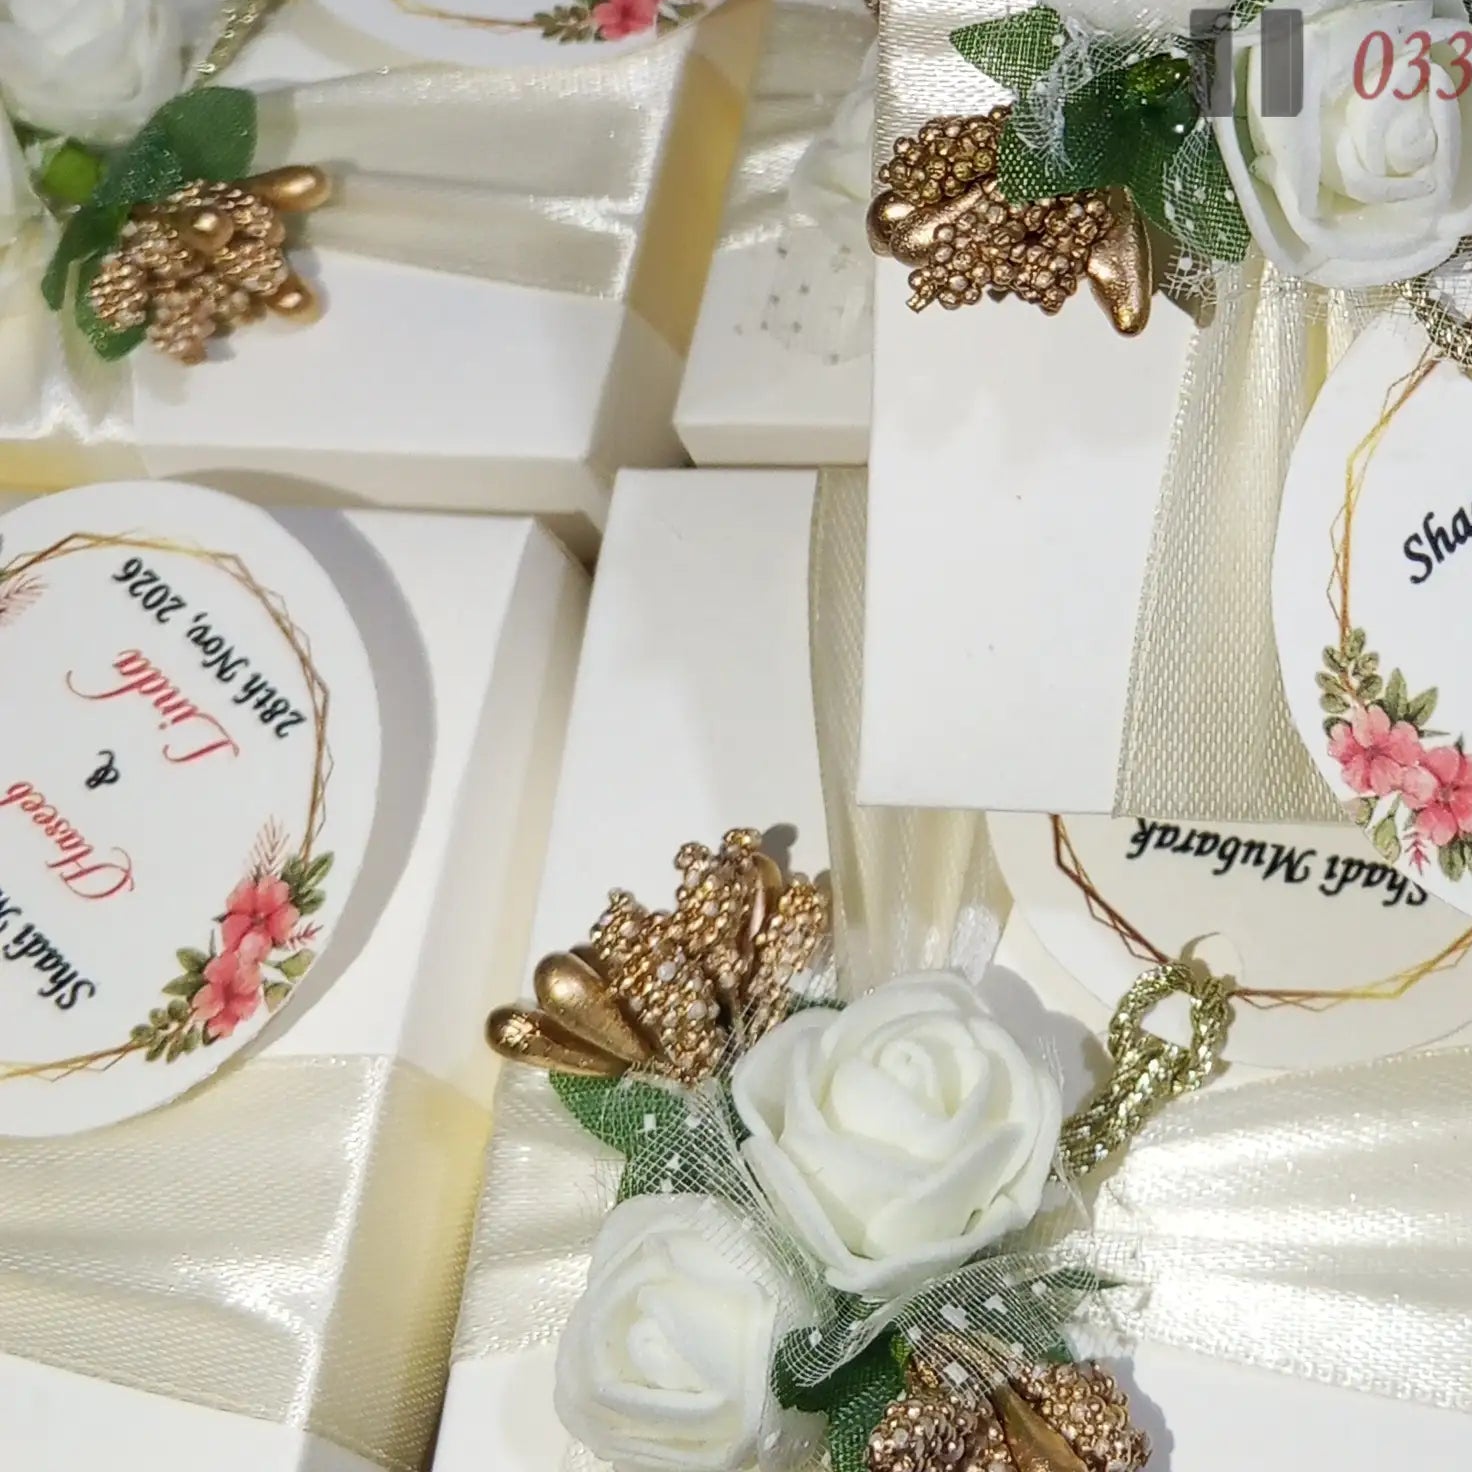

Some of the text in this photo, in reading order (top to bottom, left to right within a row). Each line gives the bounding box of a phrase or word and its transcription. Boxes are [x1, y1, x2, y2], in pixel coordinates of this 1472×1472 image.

[110, 556, 306, 738] 28th Nov, 2026
[66, 649, 239, 764] Linda
[85, 751, 119, 789] &
[1126, 818, 1316, 883] Mubarak
[2, 923, 96, 1010] Shadi
